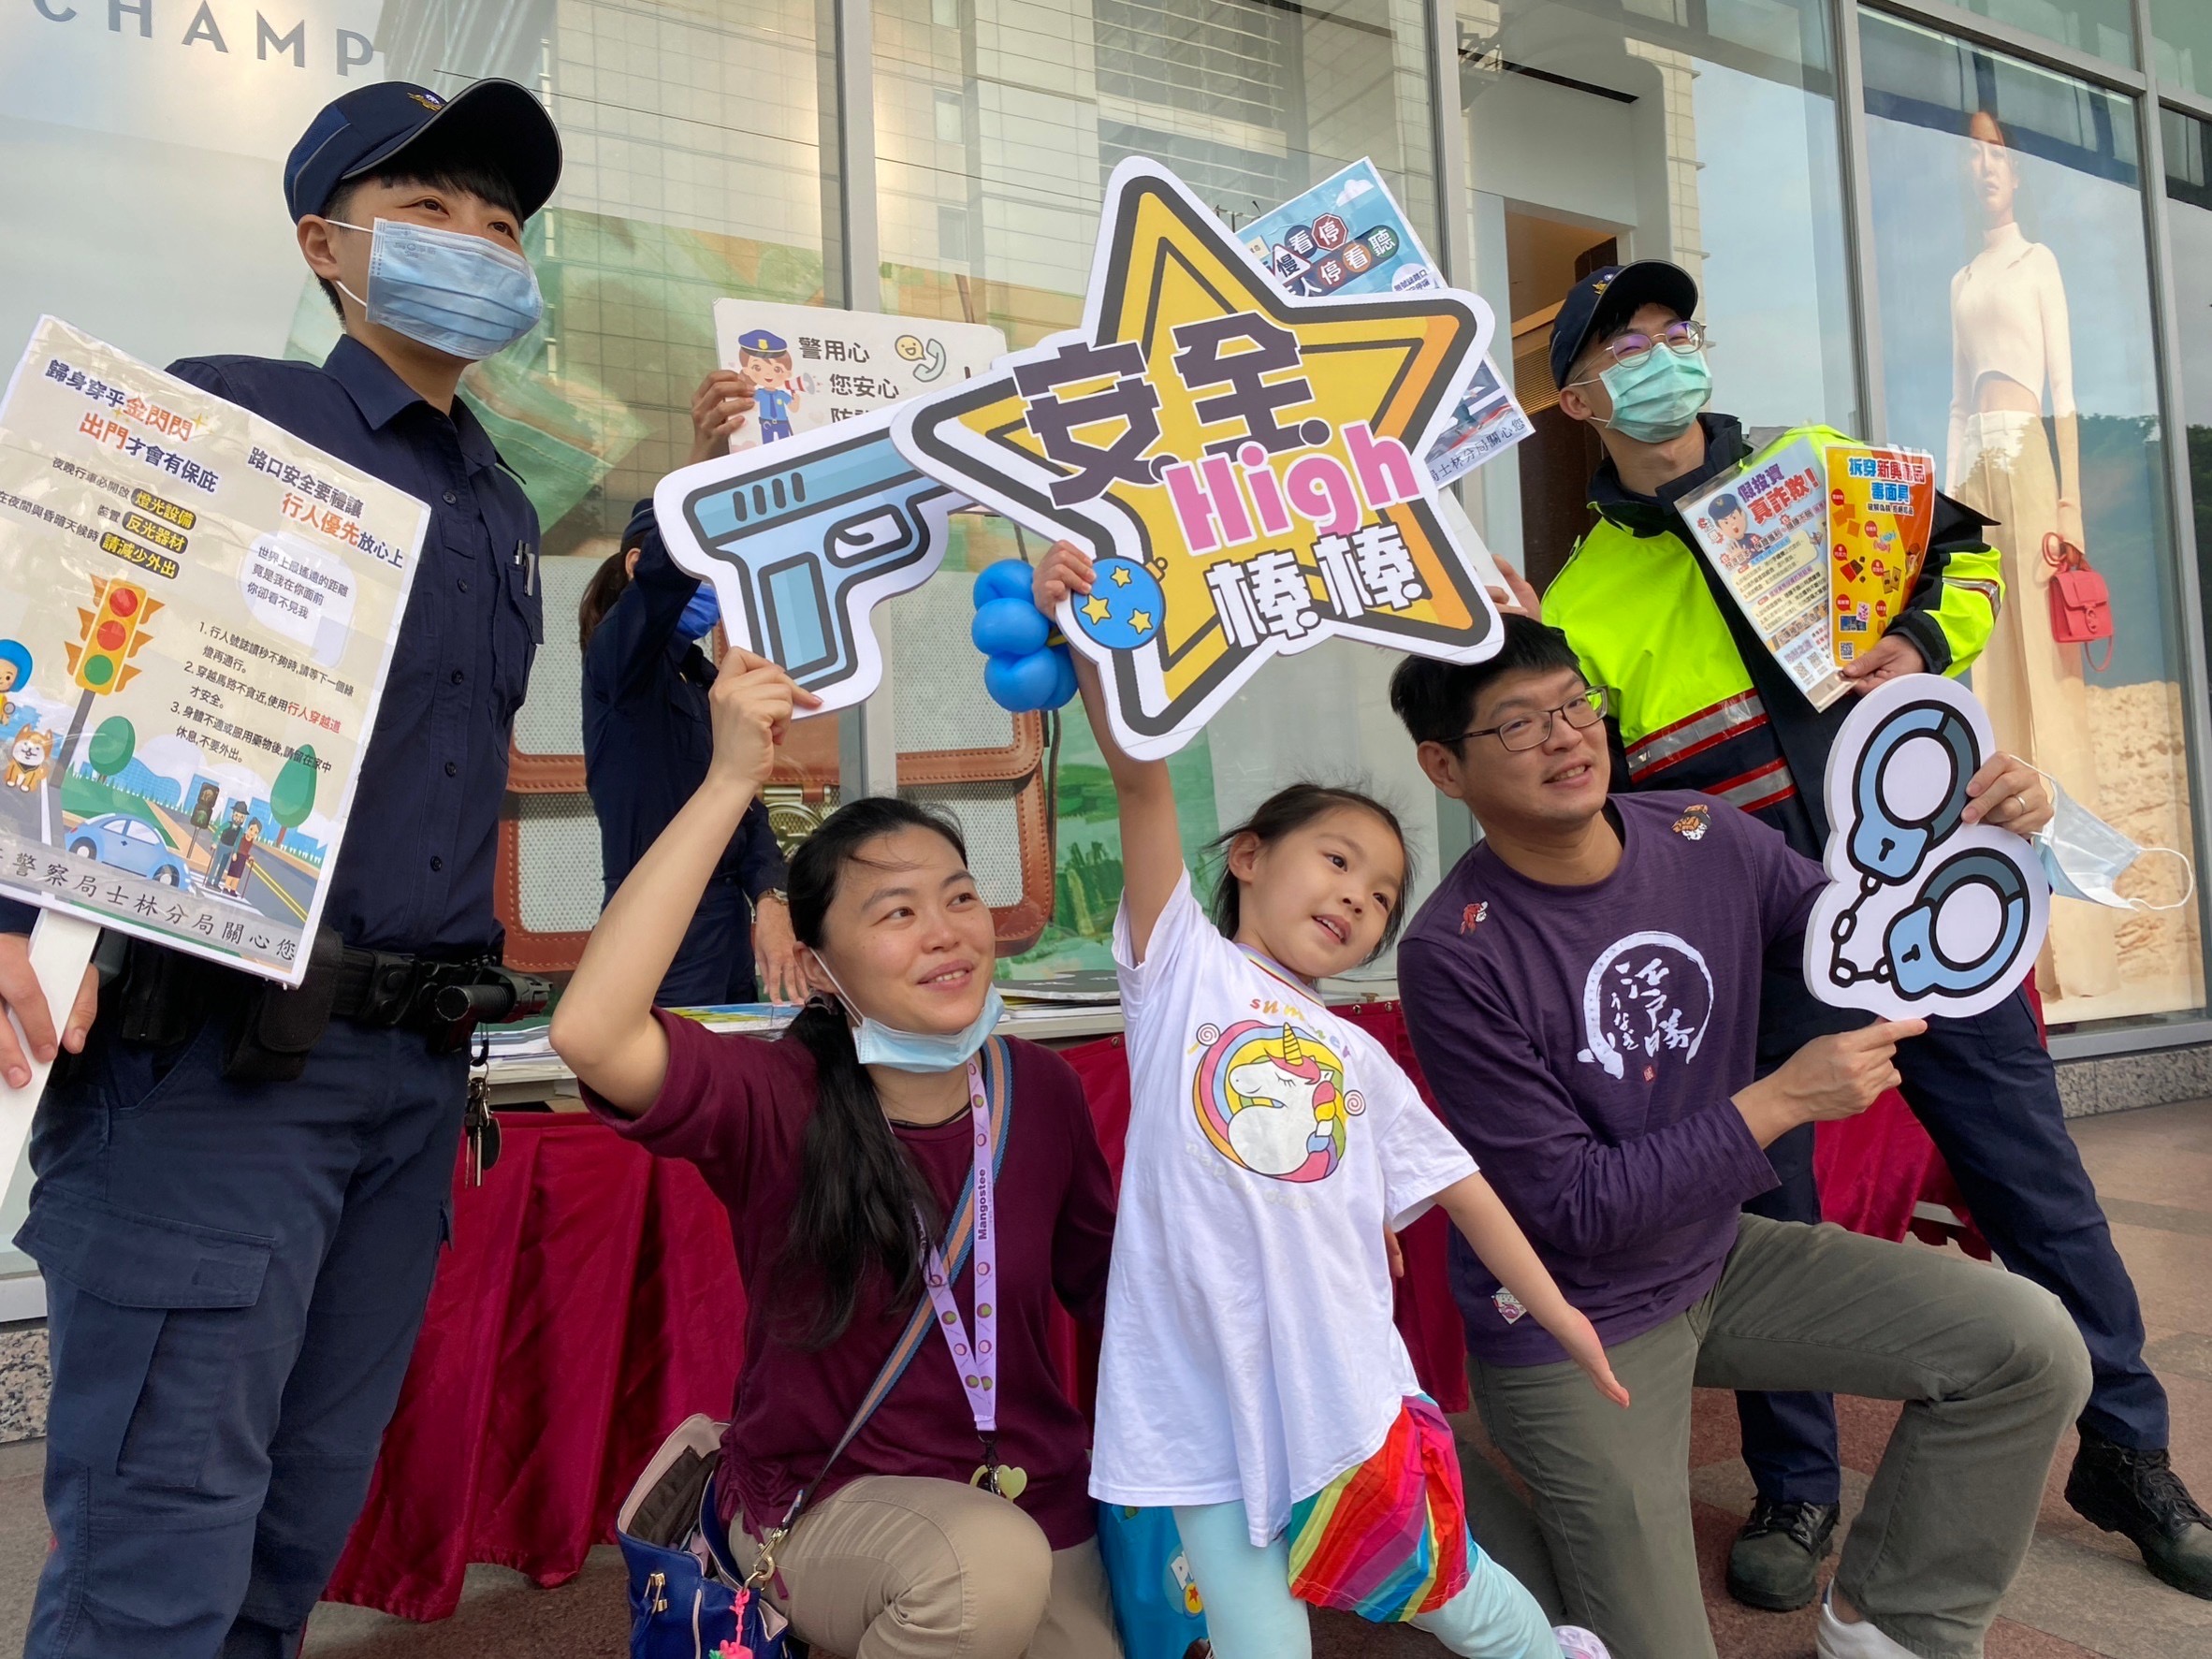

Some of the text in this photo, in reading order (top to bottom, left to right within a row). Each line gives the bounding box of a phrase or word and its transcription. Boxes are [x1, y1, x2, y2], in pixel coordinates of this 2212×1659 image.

[1287, 228, 1395, 297] 人停看聽
[798, 336, 869, 363] 警用心
[45, 359, 194, 443] 歸身穿乎金閃閃
[829, 374, 899, 400] 您安心
[1012, 312, 1332, 508] 安全
[831, 407, 868, 423] 防
[79, 412, 219, 493] 出門才會有保庇
[247, 446, 365, 518] 路口安全要禮讓
[1164, 422, 1420, 555] High
[1871, 482, 1910, 502] 毒面具
[97, 503, 186, 553] 裝置 反光器材
[135, 490, 196, 529] 燈光設備
[282, 492, 404, 569] 行人優先放心上
[102, 533, 177, 578] 請減少外出
[258, 546, 349, 598] 世界上最遙遠的距離
[247, 582, 309, 618] 你卻看不見我
[252, 563, 325, 605] 竟是我在你面前
[1205, 524, 1423, 648] 棒棒
[190, 685, 224, 709] 才安全。
[0, 847, 297, 961] 警察局士林分局關心您
[978, 1169, 988, 1241] Mangostee
